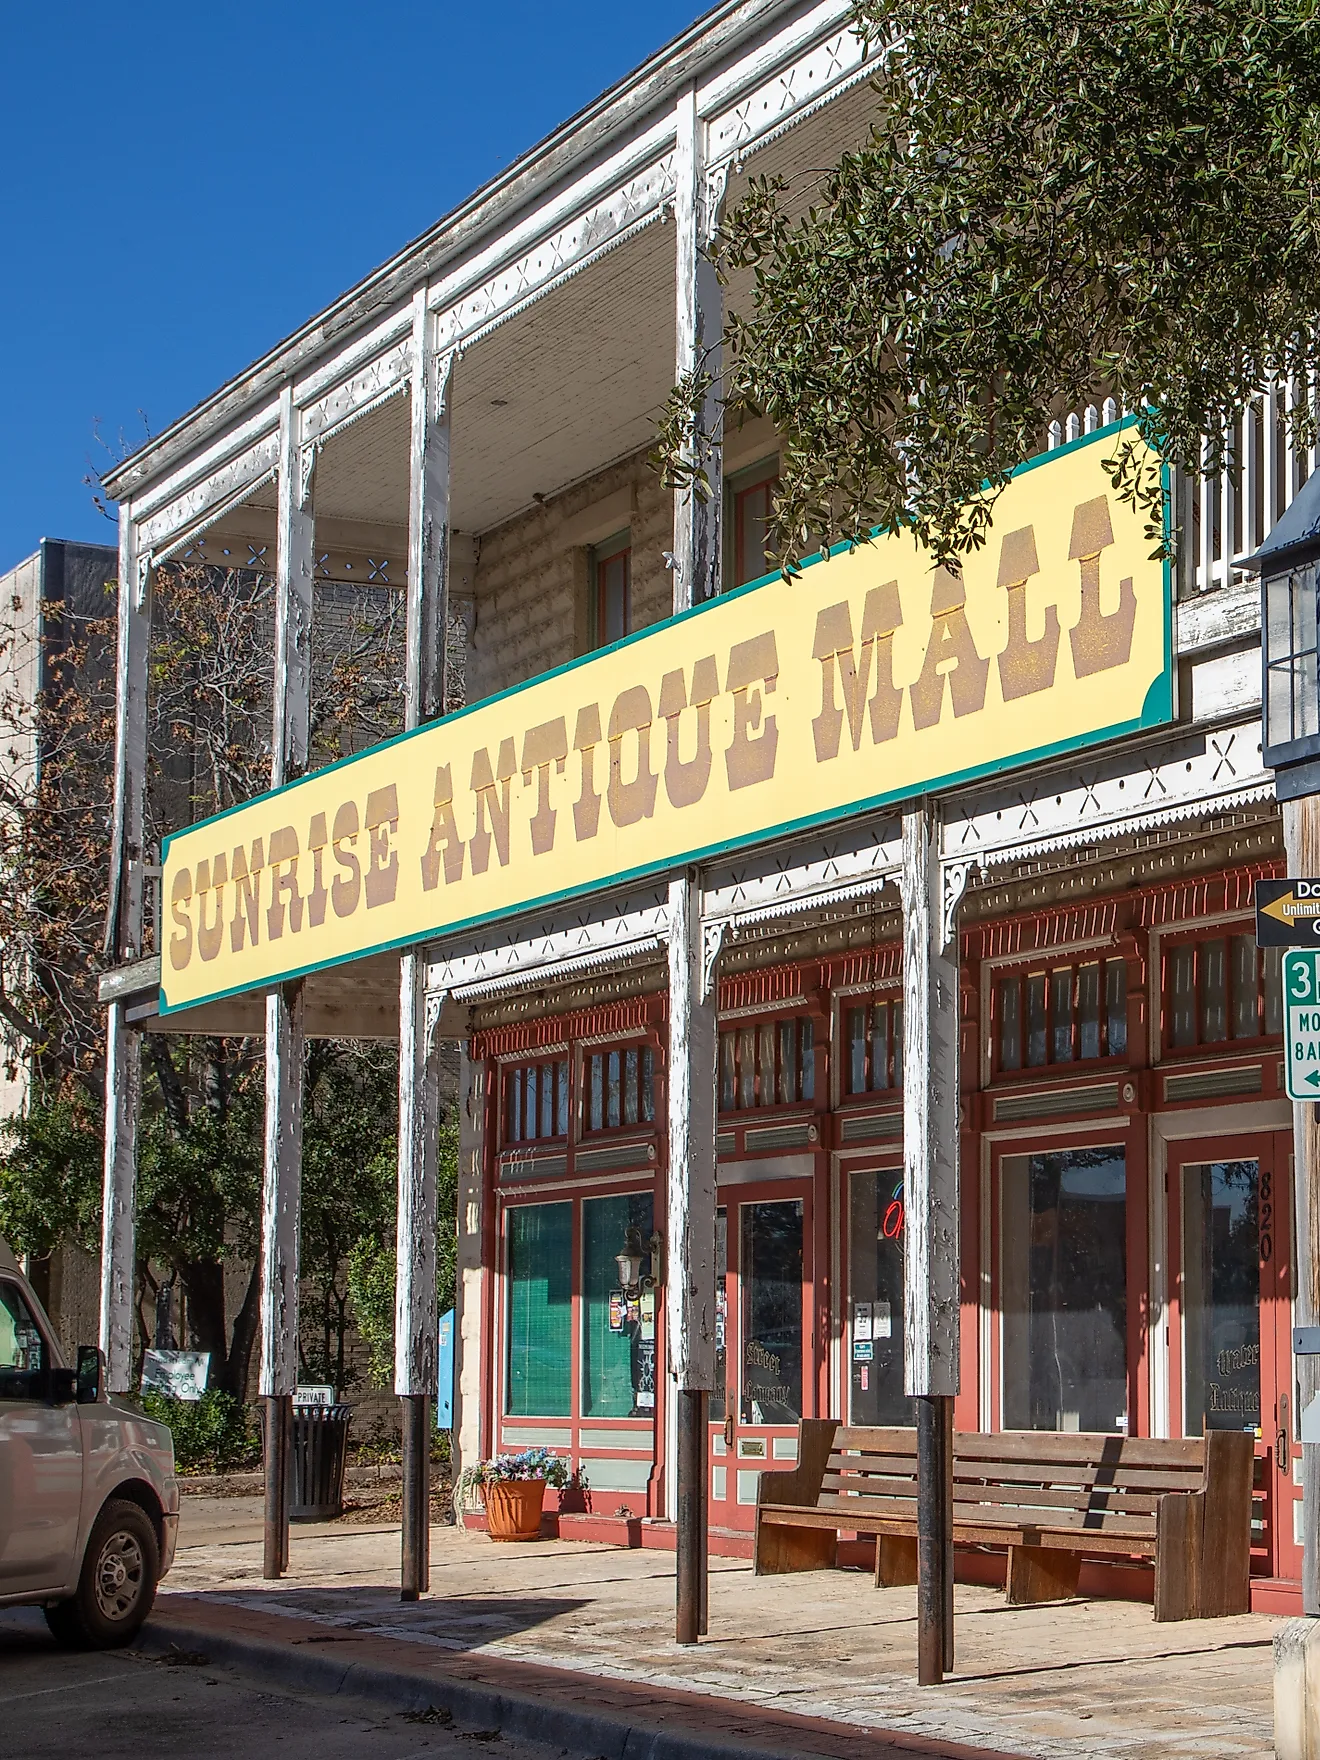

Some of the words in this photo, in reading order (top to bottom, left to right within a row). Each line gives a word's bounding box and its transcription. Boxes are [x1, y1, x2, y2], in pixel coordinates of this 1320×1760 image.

[168, 782, 400, 971] SUNRISE
[420, 629, 780, 893] ANTIQUE
[811, 494, 1138, 763] MALL
[1290, 961, 1312, 999] 3
[297, 1392, 326, 1403] PRIVATE
